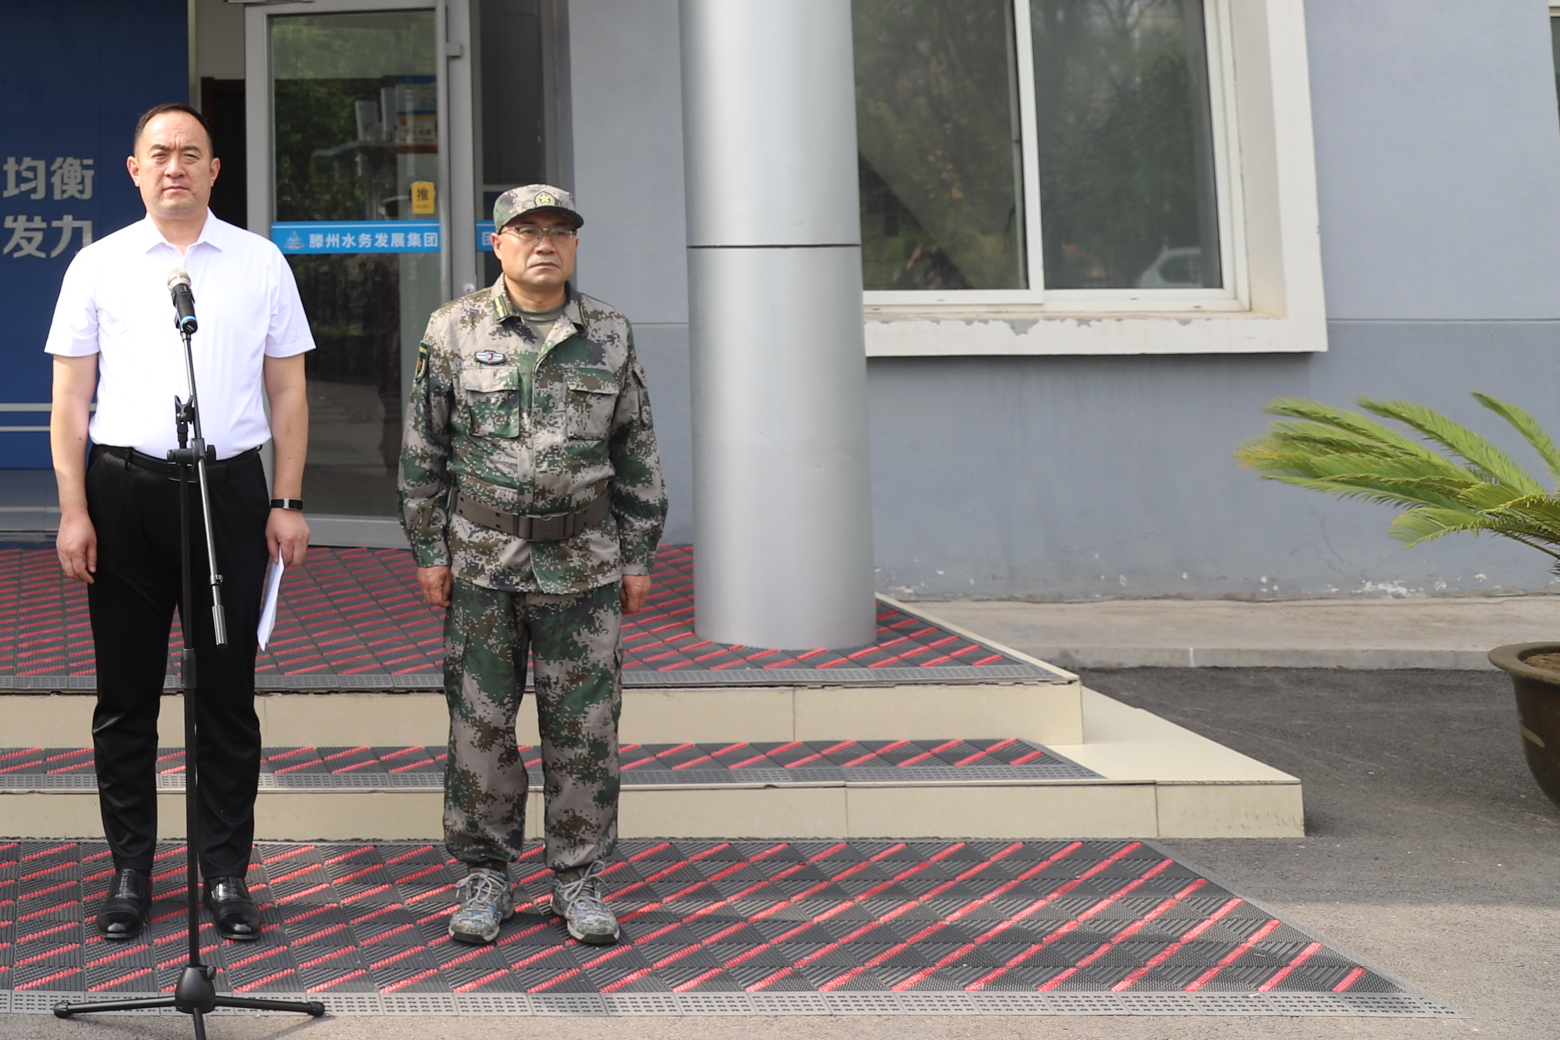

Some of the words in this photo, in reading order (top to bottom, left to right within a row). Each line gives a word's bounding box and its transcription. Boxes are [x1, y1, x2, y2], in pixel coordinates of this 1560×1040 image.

[309, 233, 439, 248] 滕州水务发展集团
